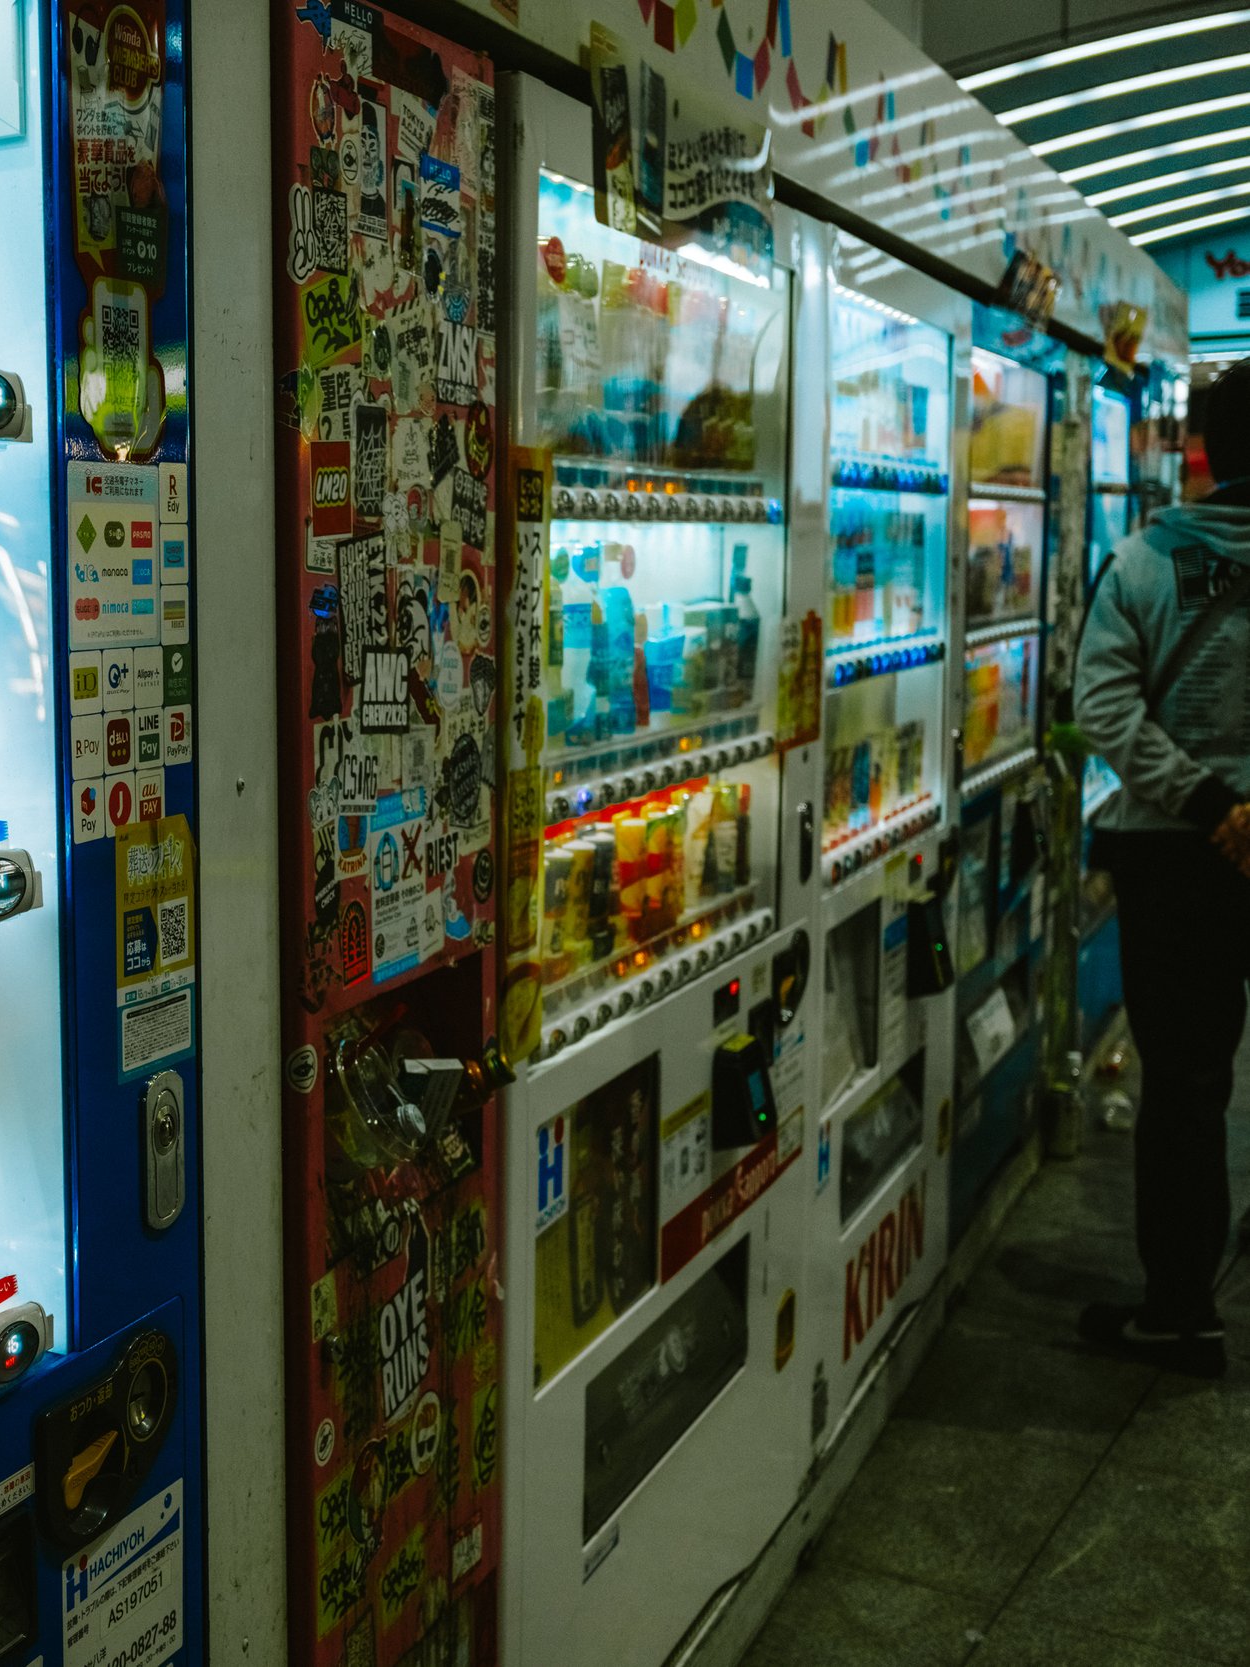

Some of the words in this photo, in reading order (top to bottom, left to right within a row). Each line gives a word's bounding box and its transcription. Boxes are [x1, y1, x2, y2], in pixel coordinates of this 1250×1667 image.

[344, 1, 373, 24] HELLO
[114, 22, 142, 47] Wonda
[112, 66, 138, 89] CLUB
[78, 166, 127, 194] 当てよう!
[167, 500, 180, 514] Edy
[102, 568, 128, 577] manaca
[102, 602, 129, 614] nimoca
[363, 651, 408, 702] AWC
[139, 714, 159, 731] LINE
[141, 740, 158, 757] Pay
[166, 744, 190, 758] PayPay
[142, 800, 158, 815] PAY
[81, 818, 96, 833] Pay
[338, 854, 368, 874] KATRINA
[127, 956, 151, 971] ココから
[844, 1174, 927, 1361] KIRIN
[380, 1268, 426, 1359] OYE
[382, 1322, 430, 1418] RUNS
[90, 1527, 145, 1581] HACHIYOH
[108, 1571, 163, 1628] AS197051
